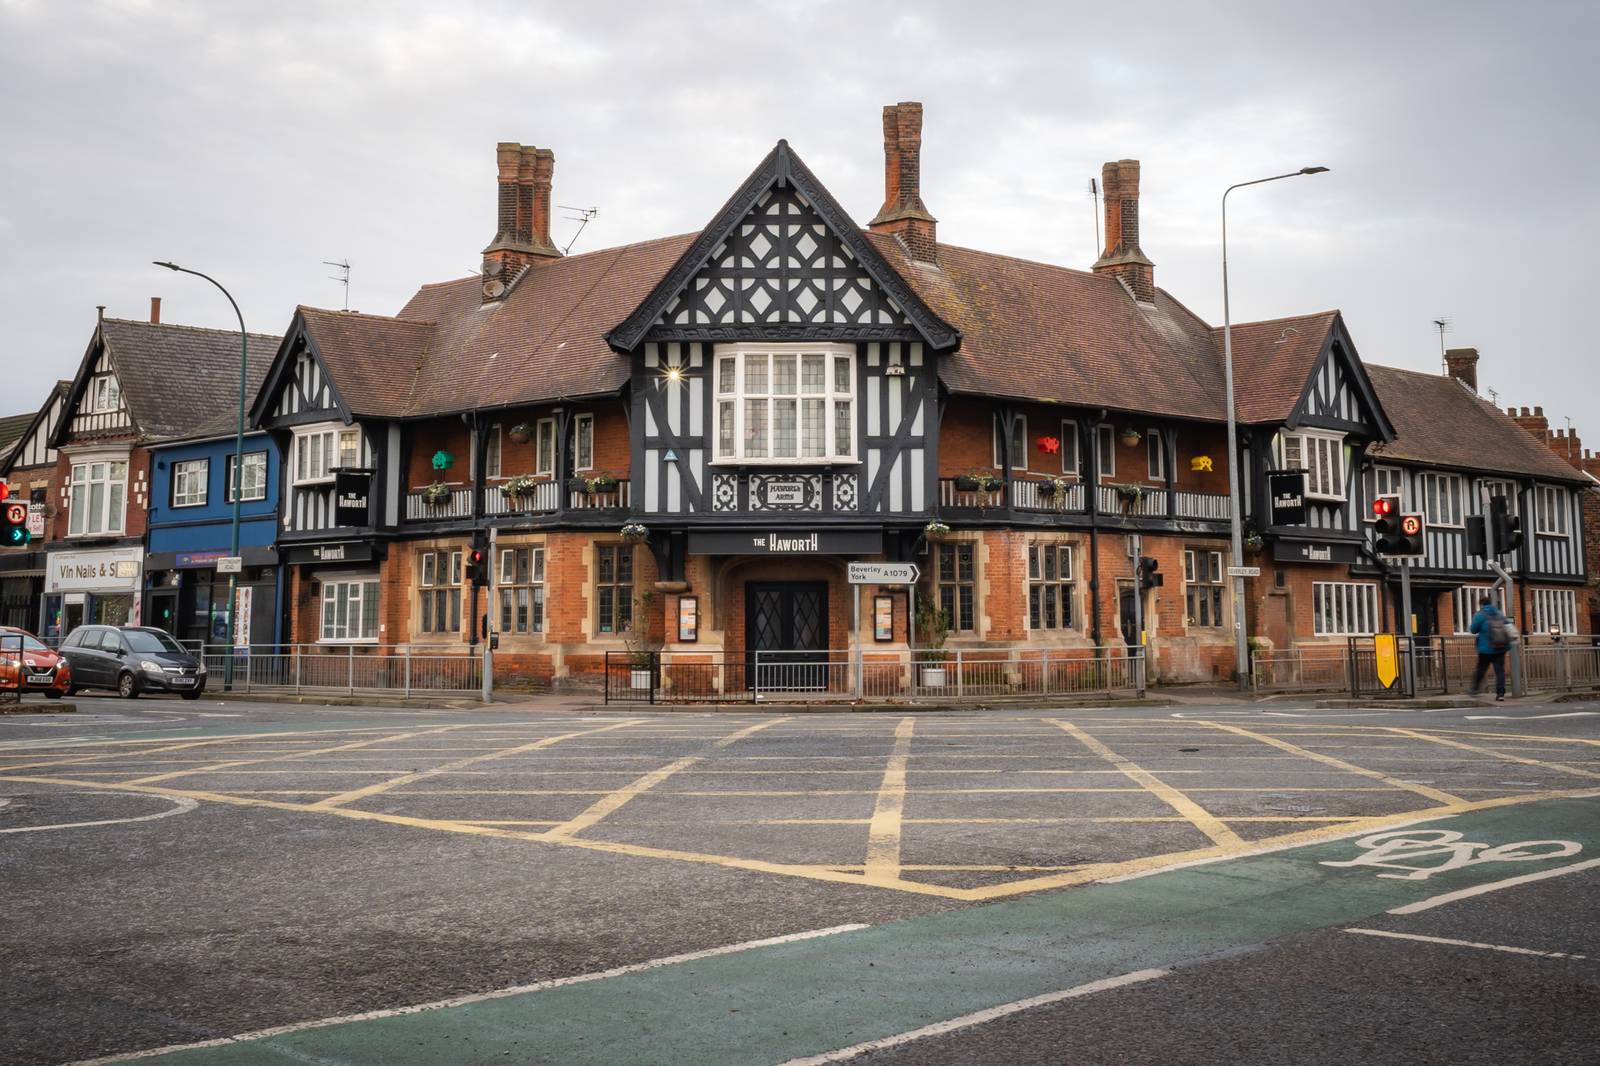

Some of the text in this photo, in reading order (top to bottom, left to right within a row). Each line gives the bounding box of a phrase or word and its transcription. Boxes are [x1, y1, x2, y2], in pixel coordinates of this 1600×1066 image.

[339, 495, 366, 508] HAWORTH
[1274, 495, 1301, 508] HAWORTH
[769, 533, 818, 551] HAWORTH
[320, 546, 344, 560] HAWORTH
[60, 565, 74, 578] Vin
[76, 564, 96, 578] Nails
[99, 562, 107, 577] &
[109, 562, 115, 576] S
[850, 565, 882, 574] Beverley
